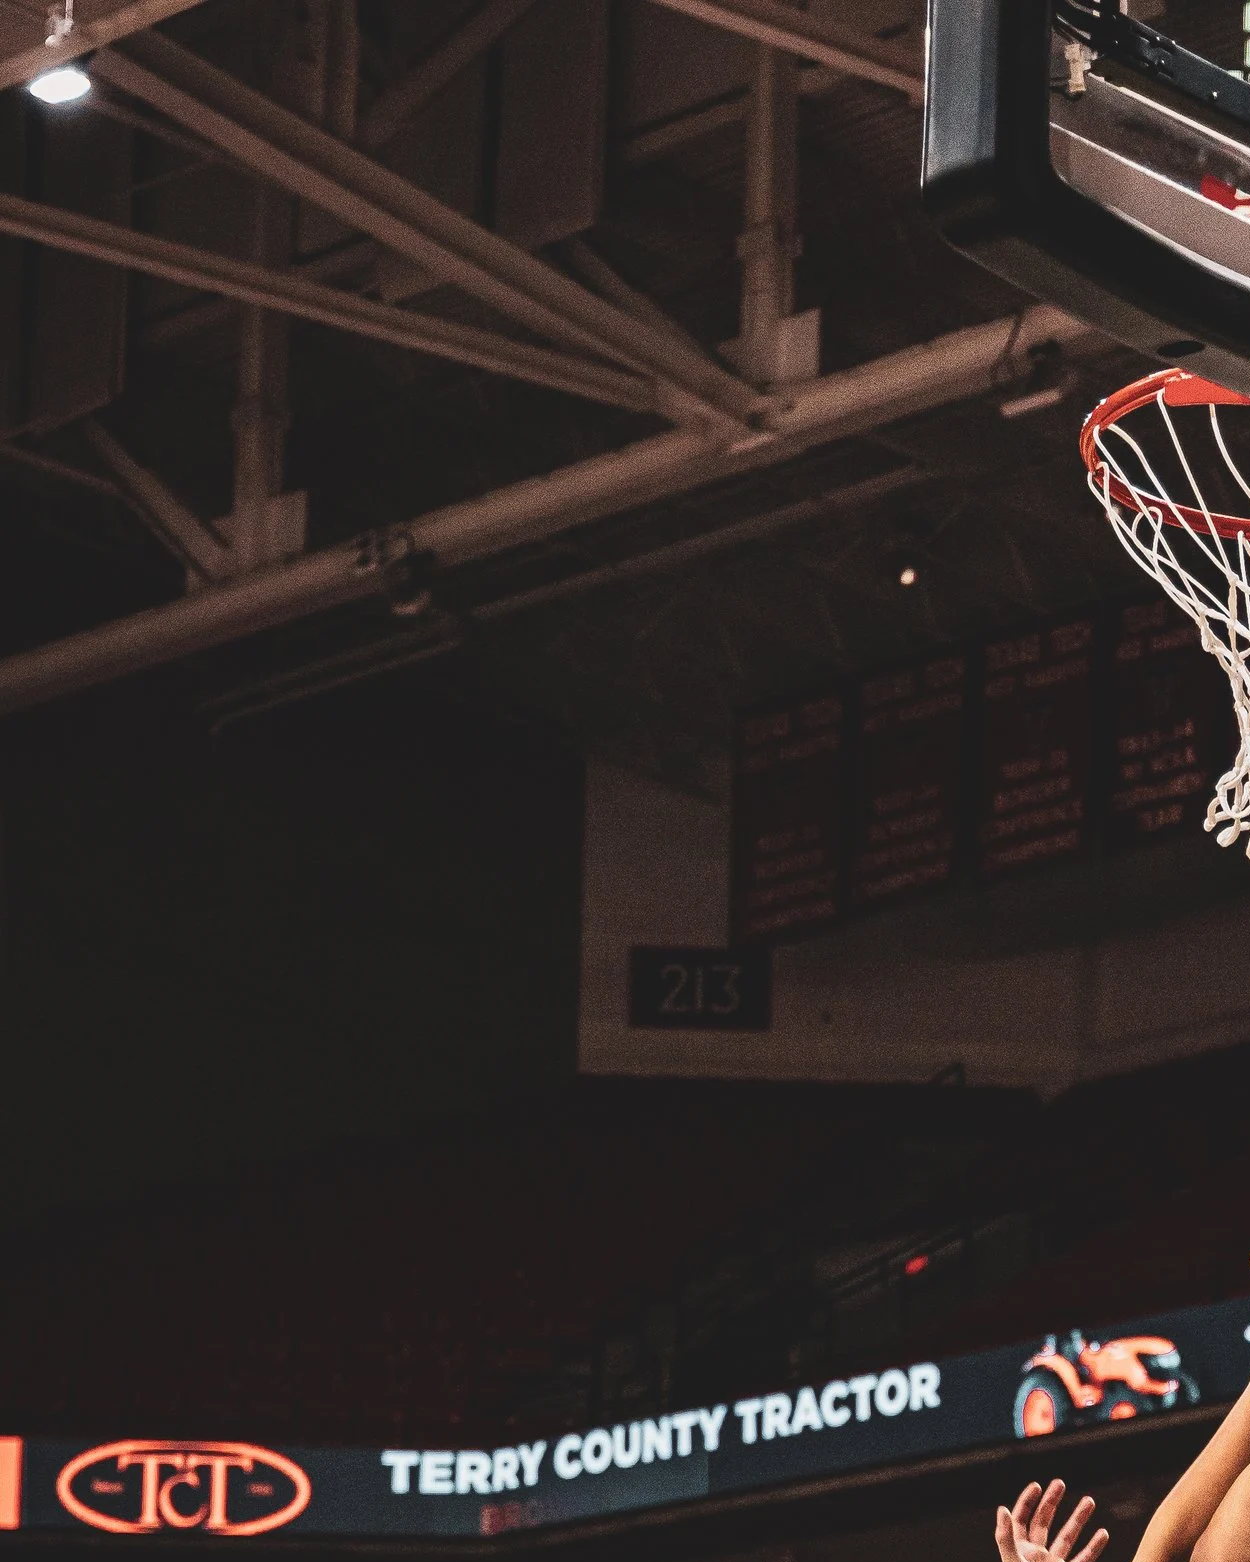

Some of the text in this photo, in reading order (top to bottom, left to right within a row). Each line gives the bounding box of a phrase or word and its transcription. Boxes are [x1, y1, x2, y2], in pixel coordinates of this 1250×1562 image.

[381, 1360, 942, 1494] TERRY COUNTY TRACTOR
